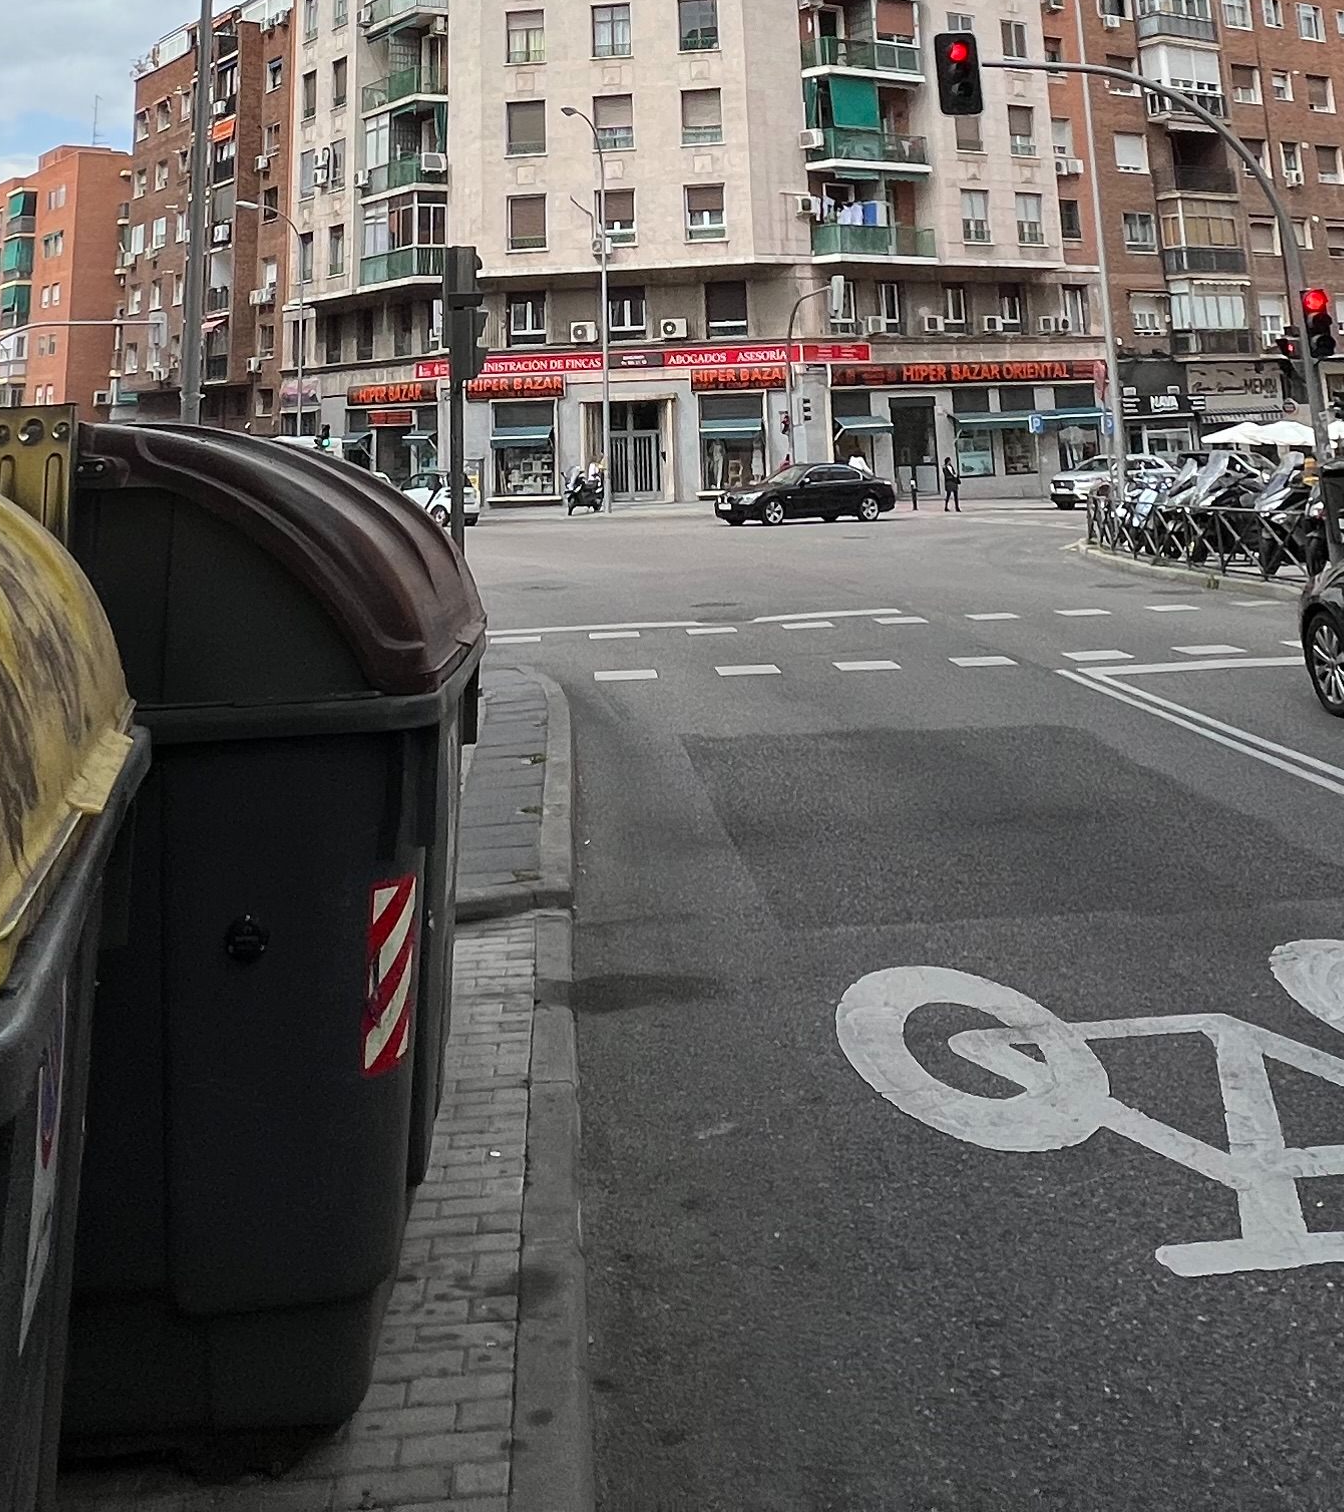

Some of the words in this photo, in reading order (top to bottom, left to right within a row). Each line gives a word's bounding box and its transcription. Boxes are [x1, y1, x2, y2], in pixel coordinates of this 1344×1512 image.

[549, 358, 565, 370] DE
[565, 357, 603, 369] FINCAS
[668, 351, 727, 366] ABOGADOS
[691, 368, 737, 382] HIPER
[902, 364, 947, 382] HIPER
[951, 363, 1000, 381] BAZAR
[1001, 361, 1071, 379] ORIENTAL
[467, 378, 509, 392] HIPER
[513, 375, 564, 390] BAZAR
[358, 386, 386, 403] HIPER
[388, 382, 423, 402] BAZAR
